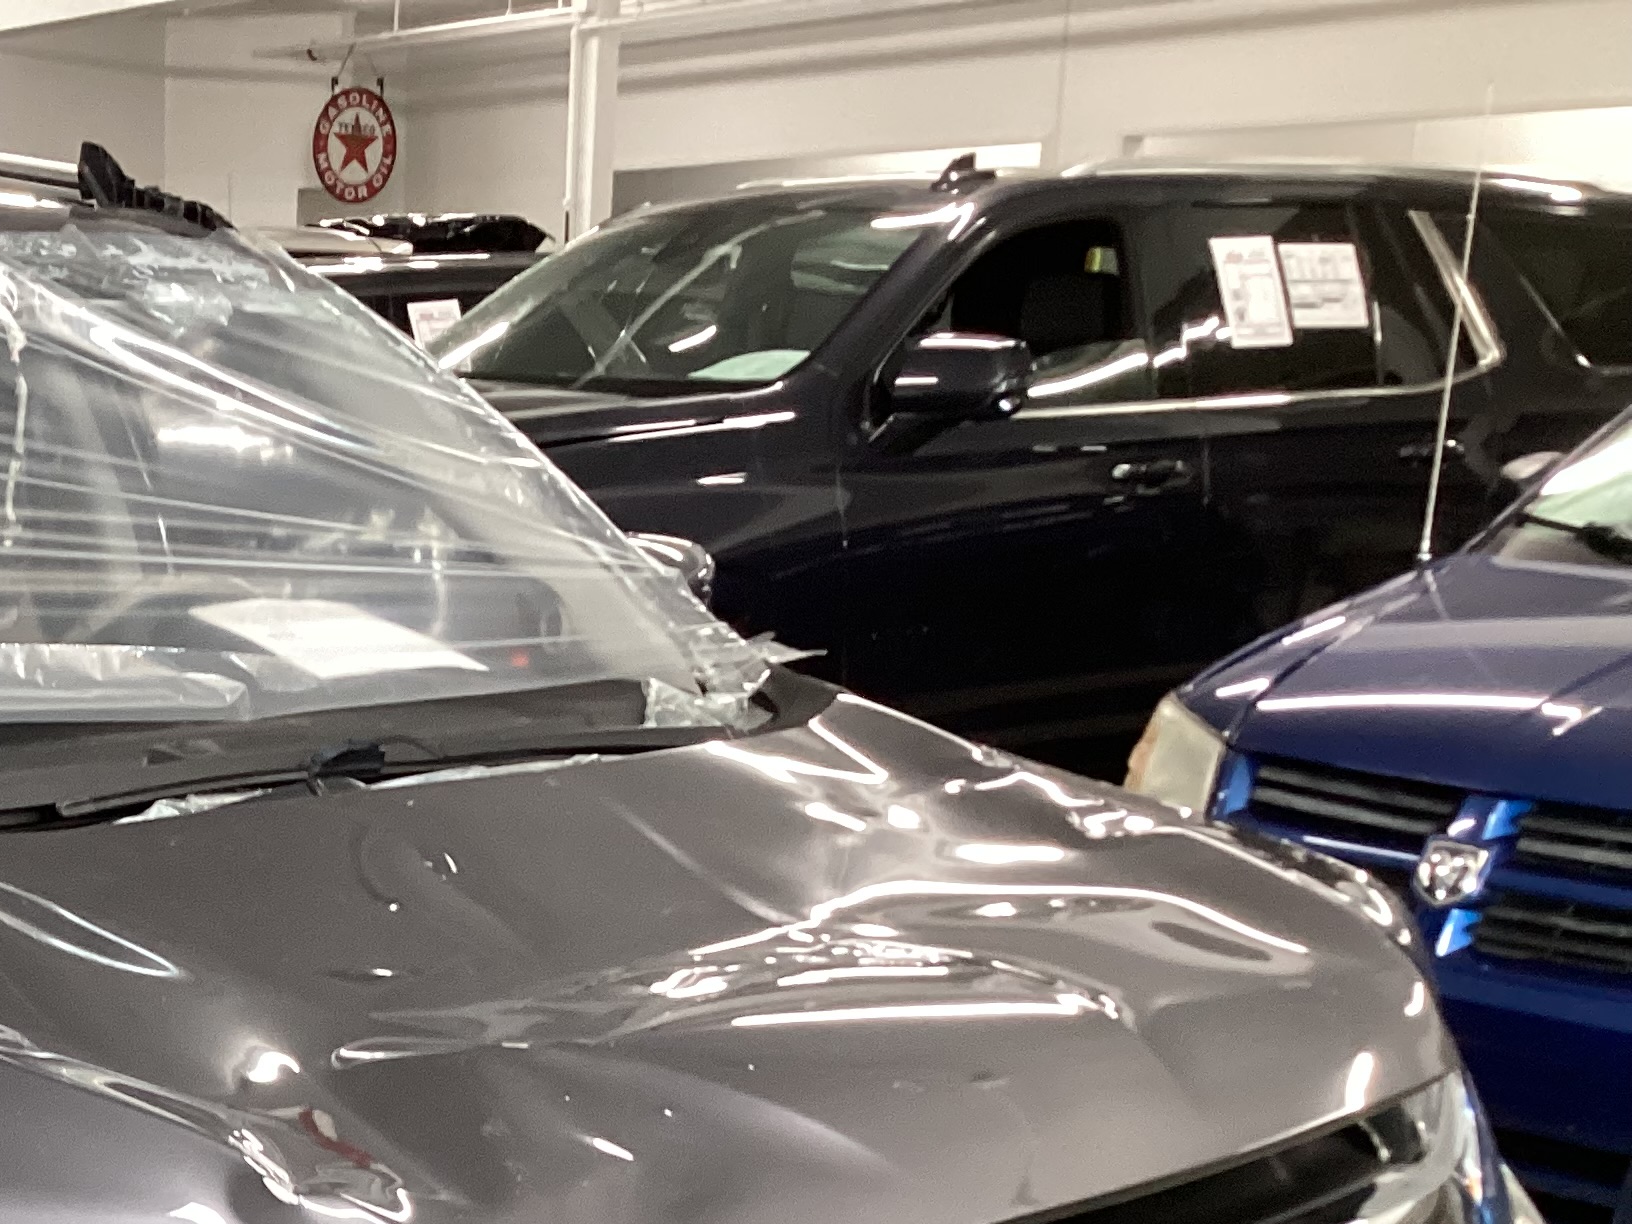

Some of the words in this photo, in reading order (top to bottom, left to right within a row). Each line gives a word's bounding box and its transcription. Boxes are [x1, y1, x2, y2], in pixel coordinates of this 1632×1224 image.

[319, 91, 393, 137] GASOLINE
[317, 151, 368, 199] MOTOR
[371, 154, 393, 188] OIL
